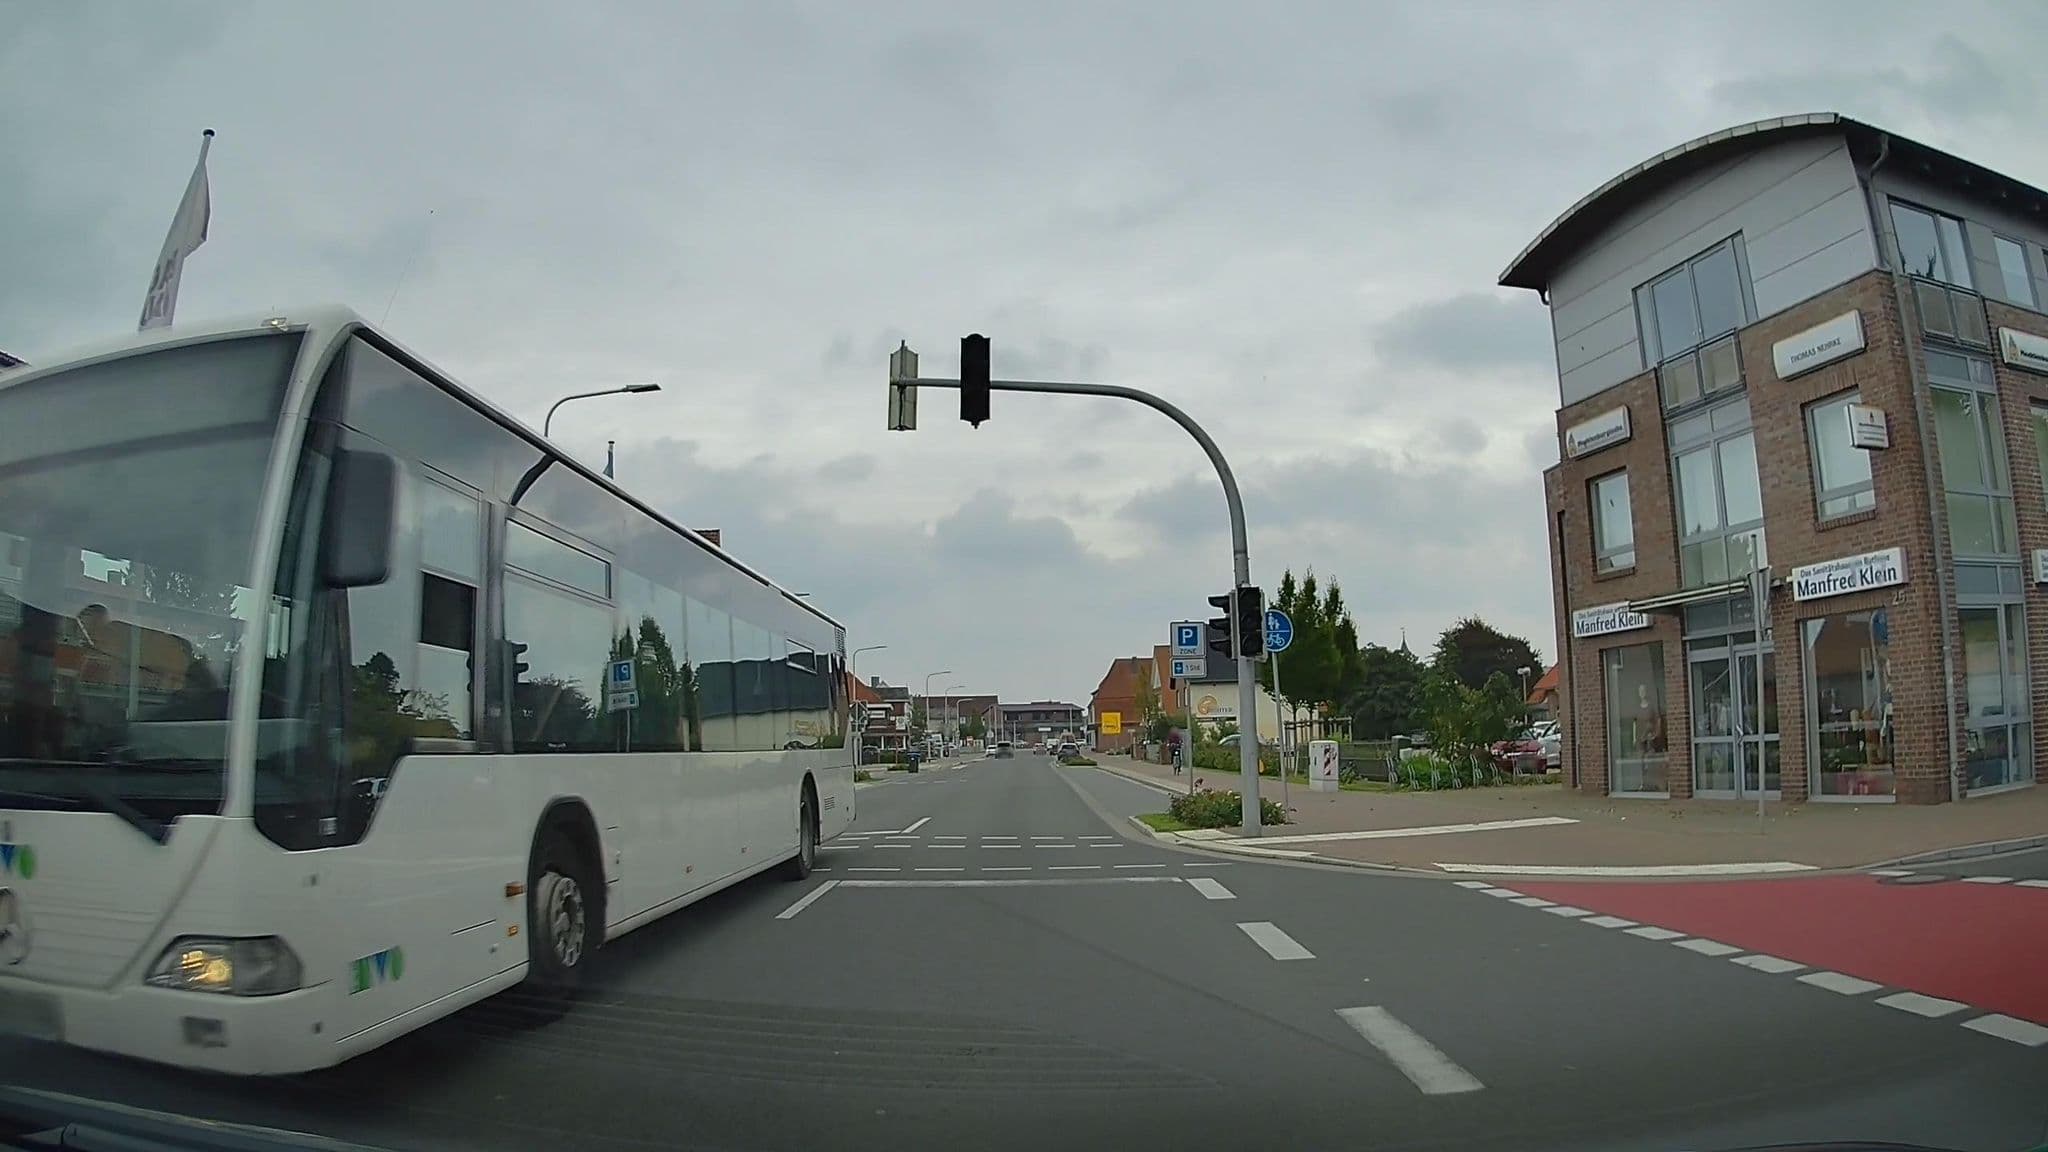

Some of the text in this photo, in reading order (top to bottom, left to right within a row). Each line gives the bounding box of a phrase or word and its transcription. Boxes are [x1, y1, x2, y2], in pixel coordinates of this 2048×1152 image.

[1797, 564, 1897, 597] Manfred Klein
[1576, 610, 1644, 634] Manfred Klein
[1182, 628, 1193, 644] P
